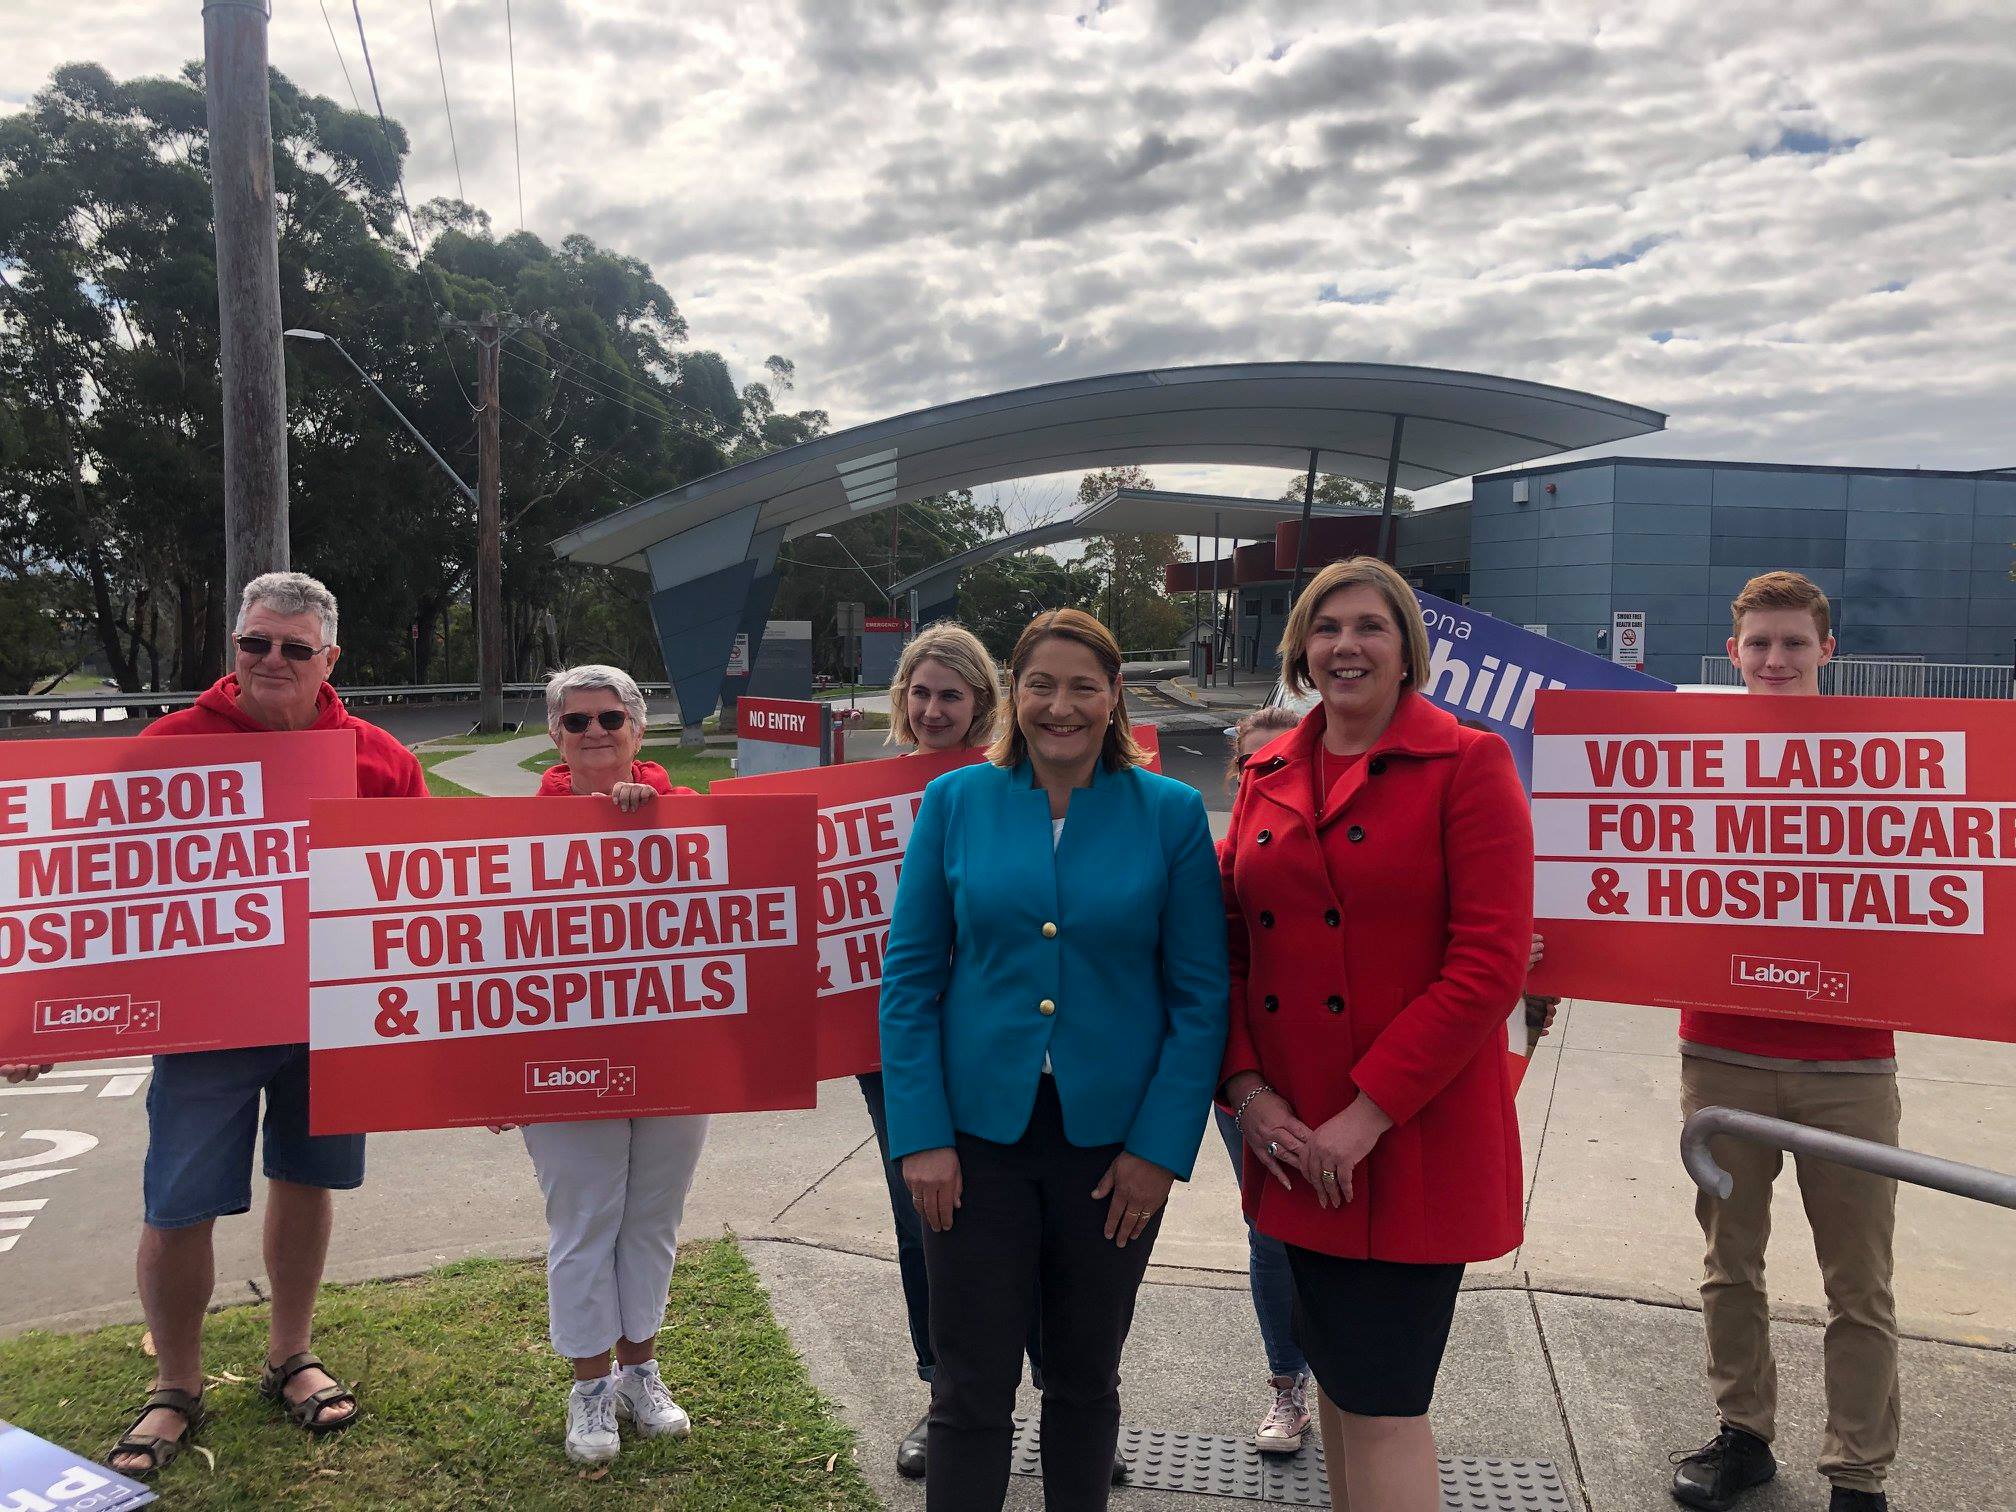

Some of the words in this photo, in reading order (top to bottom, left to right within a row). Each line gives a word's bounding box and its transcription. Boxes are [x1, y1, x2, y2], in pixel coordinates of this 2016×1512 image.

[749, 710, 765, 728] NO
[768, 712, 806, 732] ENTRY
[1585, 739, 1725, 789] VOTE
[1745, 737, 1945, 790] LABOR
[50, 770, 246, 831] LABOR
[1588, 803, 1696, 854] FOR
[817, 803, 899, 863] OTE
[366, 843, 512, 902] VOTE
[529, 832, 712, 892] LABOR
[817, 871, 884, 926] OR
[1586, 867, 1629, 916] &
[1647, 868, 1970, 928] HOSPITALS
[0, 893, 271, 968] OSPITALS
[372, 912, 484, 970] FOR
[503, 892, 788, 961] MEDICARE
[374, 986, 420, 1038] &
[437, 961, 736, 1033] HOSPITALS
[1739, 960, 1811, 987] Labor
[43, 1002, 120, 1028] Labor
[533, 1066, 601, 1088] Labor
